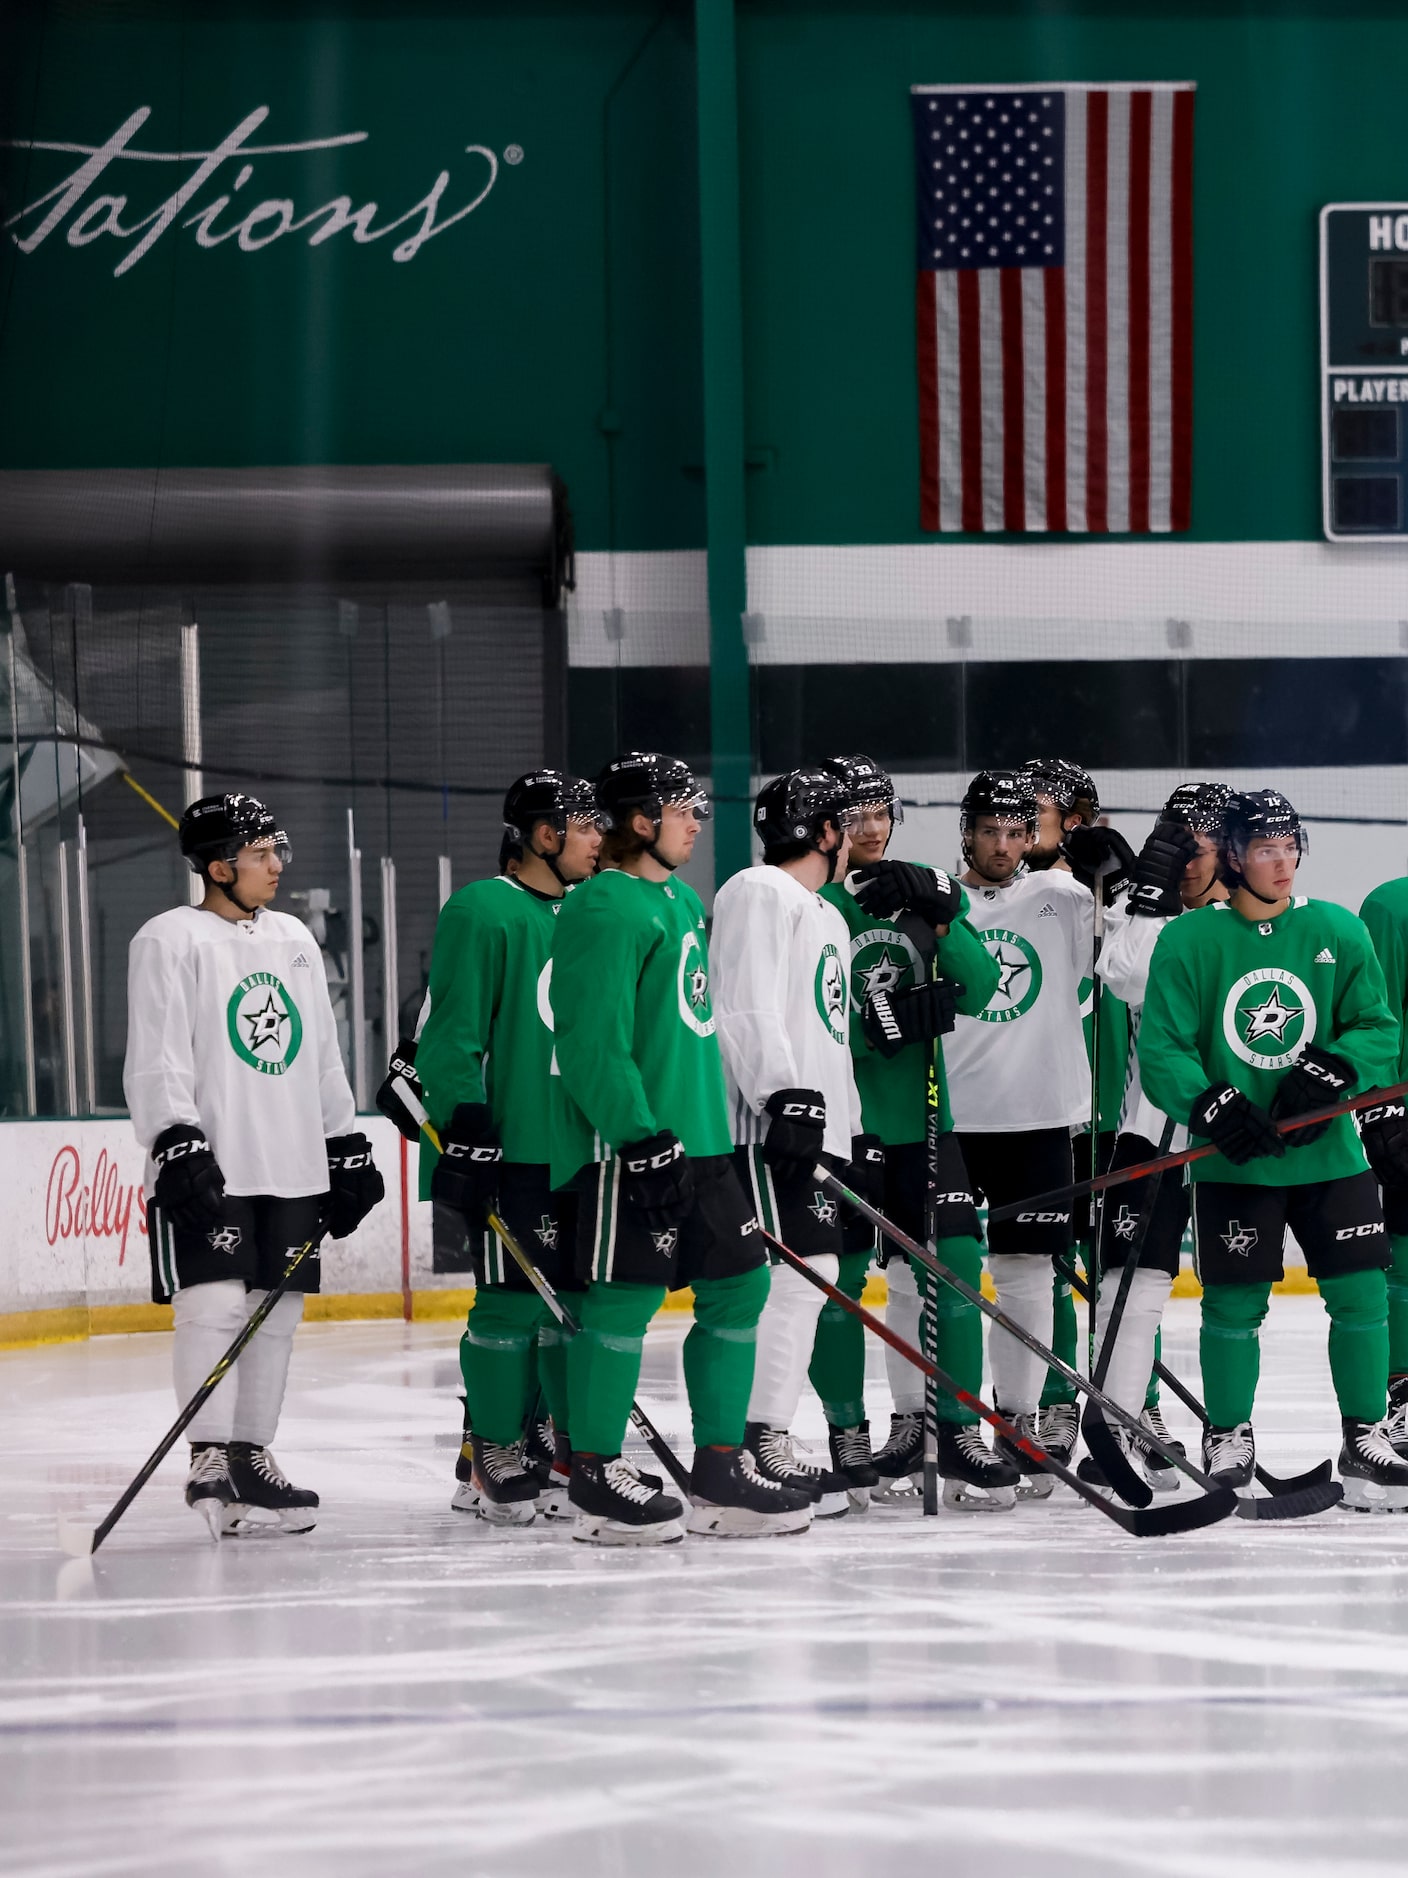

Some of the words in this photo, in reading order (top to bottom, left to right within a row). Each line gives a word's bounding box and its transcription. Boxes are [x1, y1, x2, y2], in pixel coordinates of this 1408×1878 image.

[1266, 815, 1291, 823] CCM
[855, 931, 902, 949] DALLAS
[980, 929, 1019, 945] LLAS
[1243, 969, 1295, 987] DALLAS
[1249, 1053, 1294, 1066] STARS
[781, 1103, 826, 1120] CC
[1202, 1086, 1240, 1124] CC
[1016, 1212, 1071, 1224] CCM
[1335, 1222, 1385, 1241] CCM
